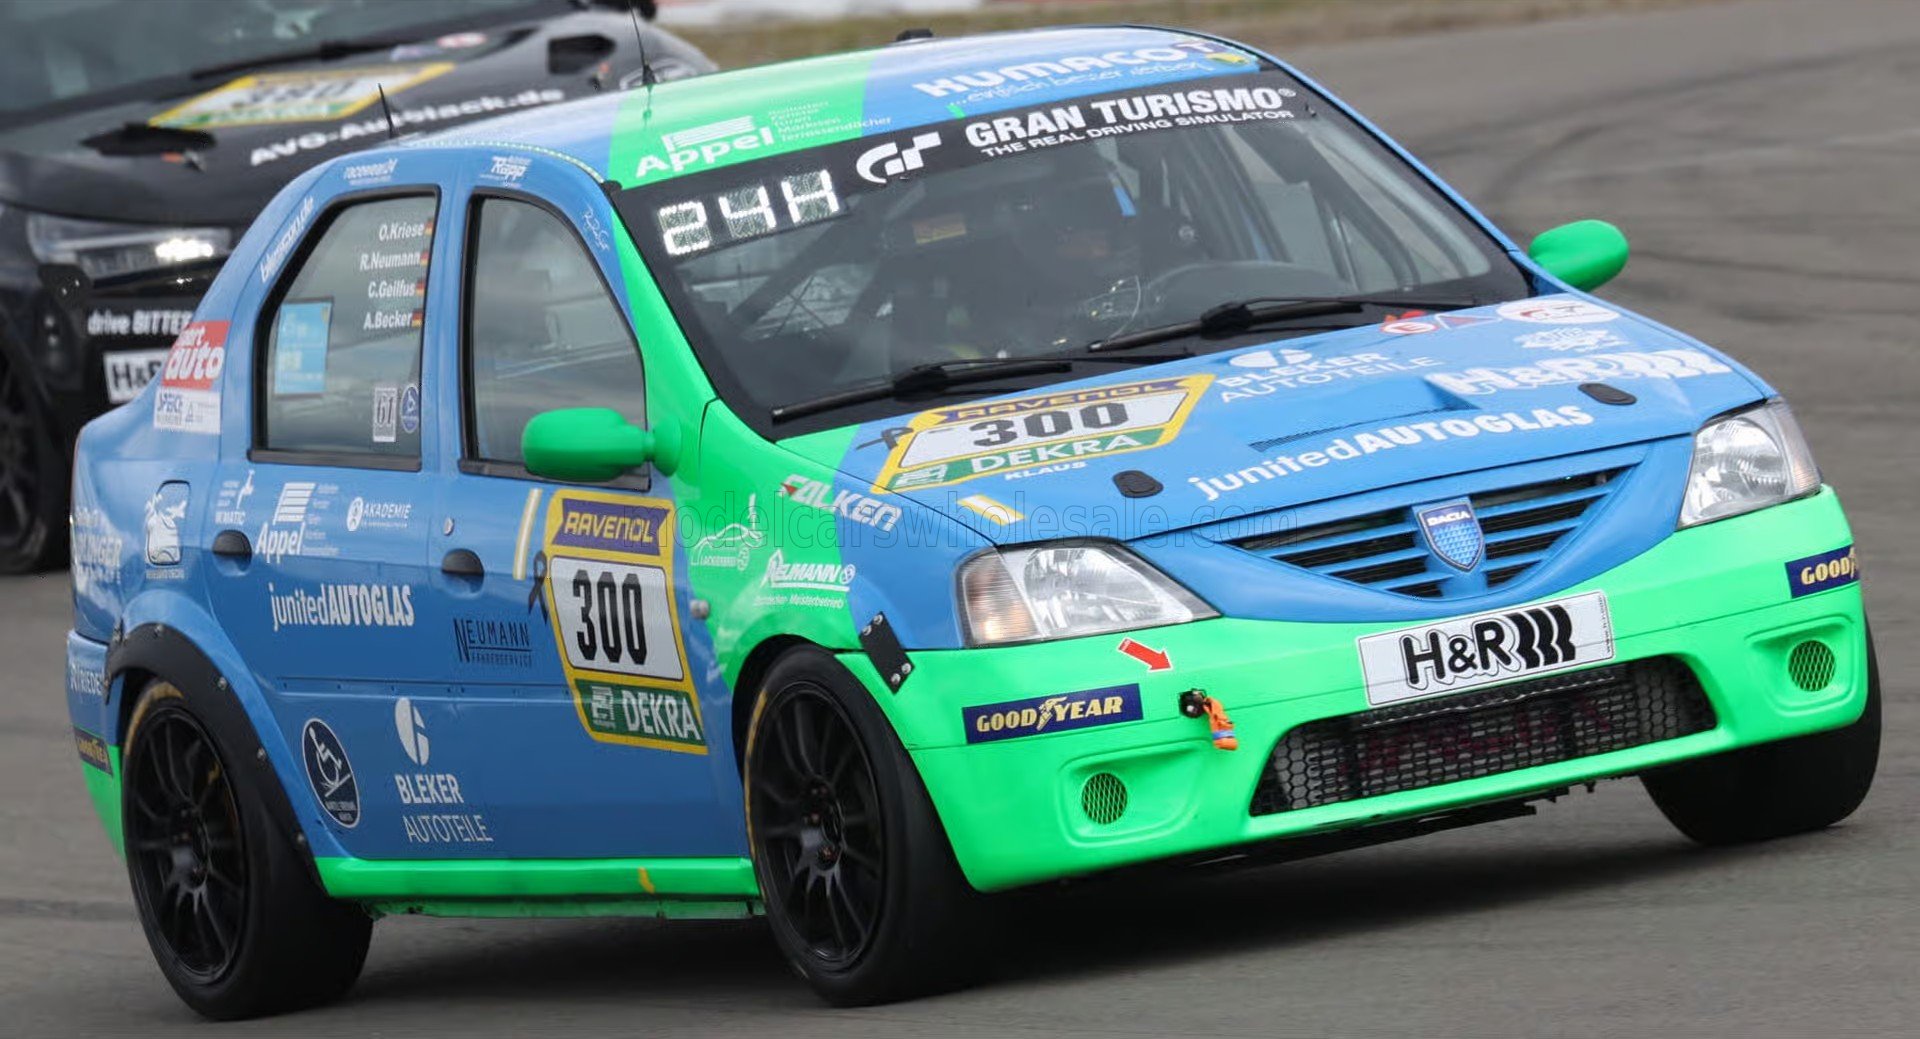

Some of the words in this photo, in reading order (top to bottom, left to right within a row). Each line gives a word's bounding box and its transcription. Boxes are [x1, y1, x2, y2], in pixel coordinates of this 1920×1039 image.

[964, 107, 1086, 148] GRAN
[981, 145, 1028, 159] THE
[1028, 134, 1084, 150] REAL
[1085, 121, 1172, 139] DRIVING
[1173, 110, 1294, 126] SIMULATOR
[635, 127, 774, 178] Appel
[379, 222, 424, 241] O.Kriese
[658, 168, 841, 256] 24H
[360, 252, 421, 271] R.Neumann
[87, 309, 130, 334] drive
[363, 313, 412, 330] A.Becker
[165, 342, 225, 380] auto
[1216, 352, 1389, 387] BLEKER
[1221, 357, 1447, 402] AUTOTEILE
[957, 382, 1175, 418] RAVENOL
[969, 402, 1130, 447] 300
[970, 434, 1143, 473] DEKRA
[1004, 461, 1087, 481] KLAUS
[1188, 405, 1595, 500] junitedAUTOGLAS
[363, 503, 412, 519] AKADEMIE
[778, 473, 902, 532] FALKEN
[1426, 511, 1471, 526] DACIA
[255, 521, 306, 564] Appel
[563, 511, 654, 543] RAVENOL
[761, 549, 843, 588] NEUMANN
[269, 582, 415, 631] junitedAUTOGLAS
[572, 569, 648, 665] 300
[453, 617, 530, 662] NEUMANN
[1401, 620, 1509, 686] H&R
[621, 689, 701, 740] DEKRA
[976, 696, 1123, 733] GOODYEAR
[394, 773, 464, 804] BLEKER
[402, 814, 494, 843] AUTOTEILE
